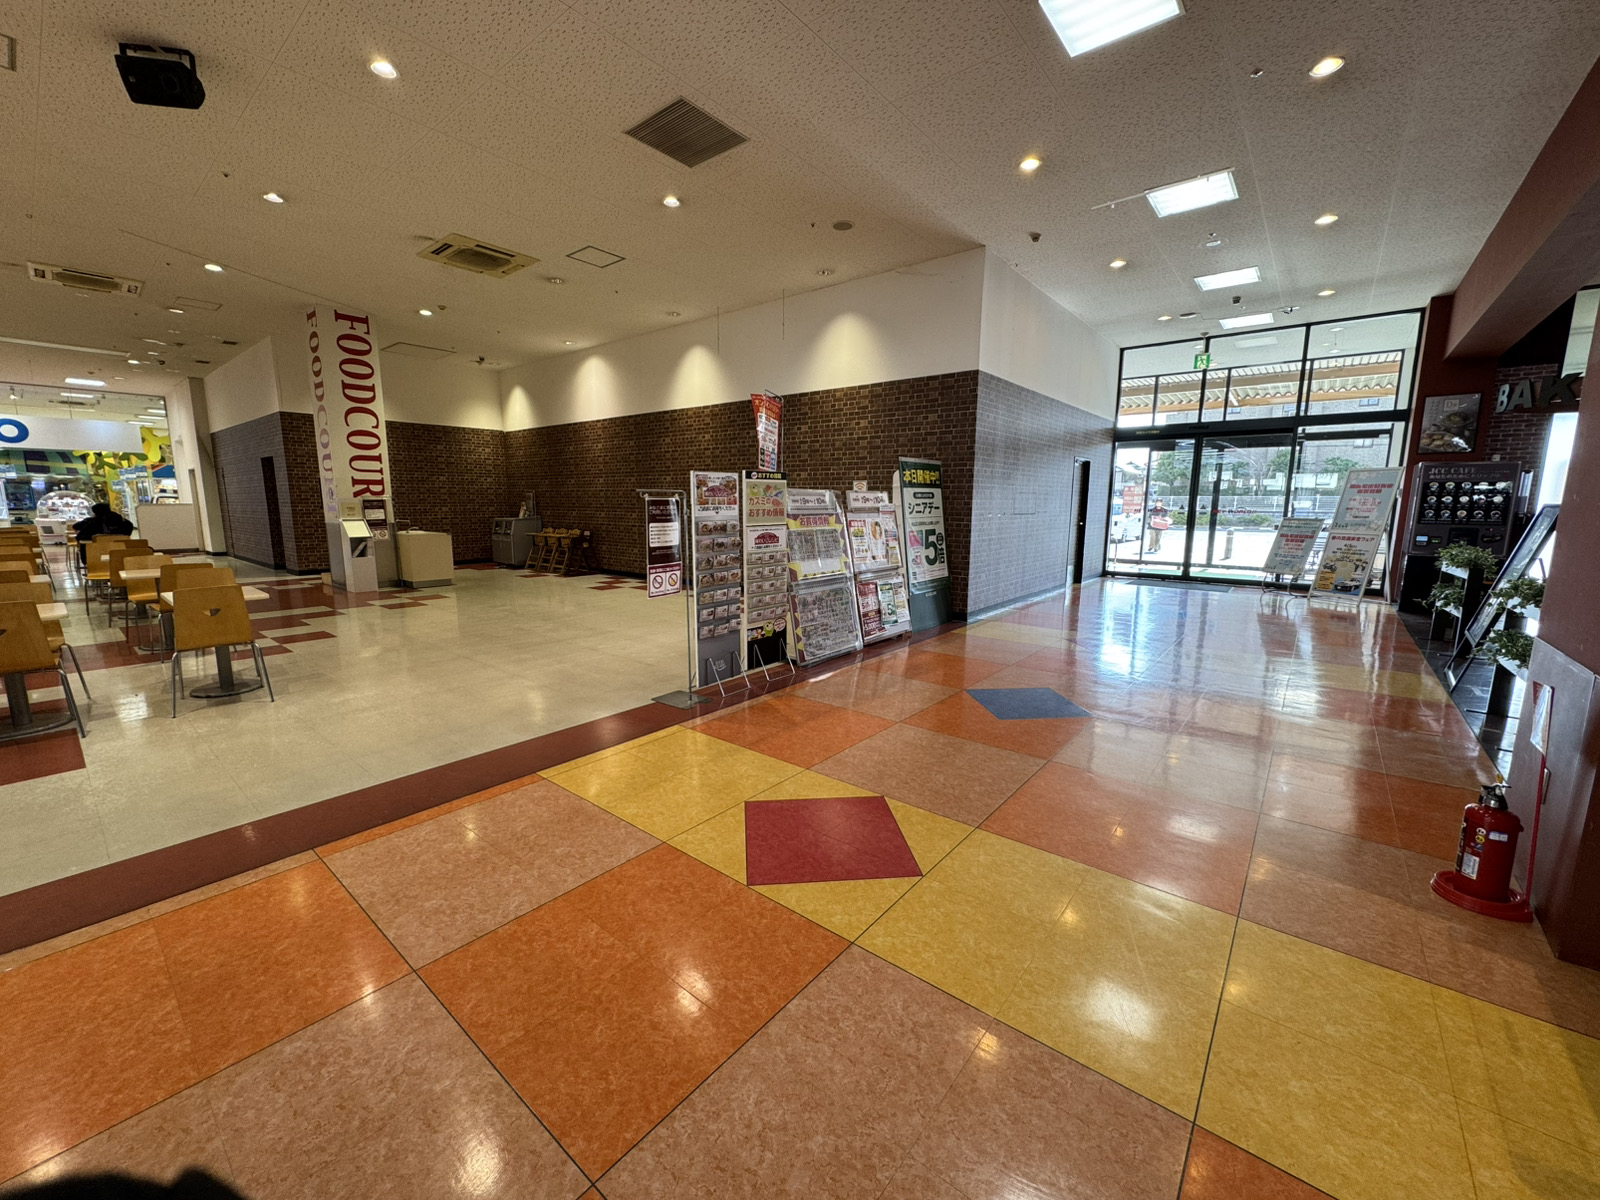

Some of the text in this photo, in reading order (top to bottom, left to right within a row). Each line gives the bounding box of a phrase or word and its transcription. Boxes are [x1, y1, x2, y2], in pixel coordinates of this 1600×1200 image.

[333, 309, 386, 499] FOODCOUR
[748, 497, 772, 506] カスミの
[908, 501, 940, 515] シニアデー
[748, 508, 785, 518] おすすめ情報
[924, 529, 938, 566] 5
